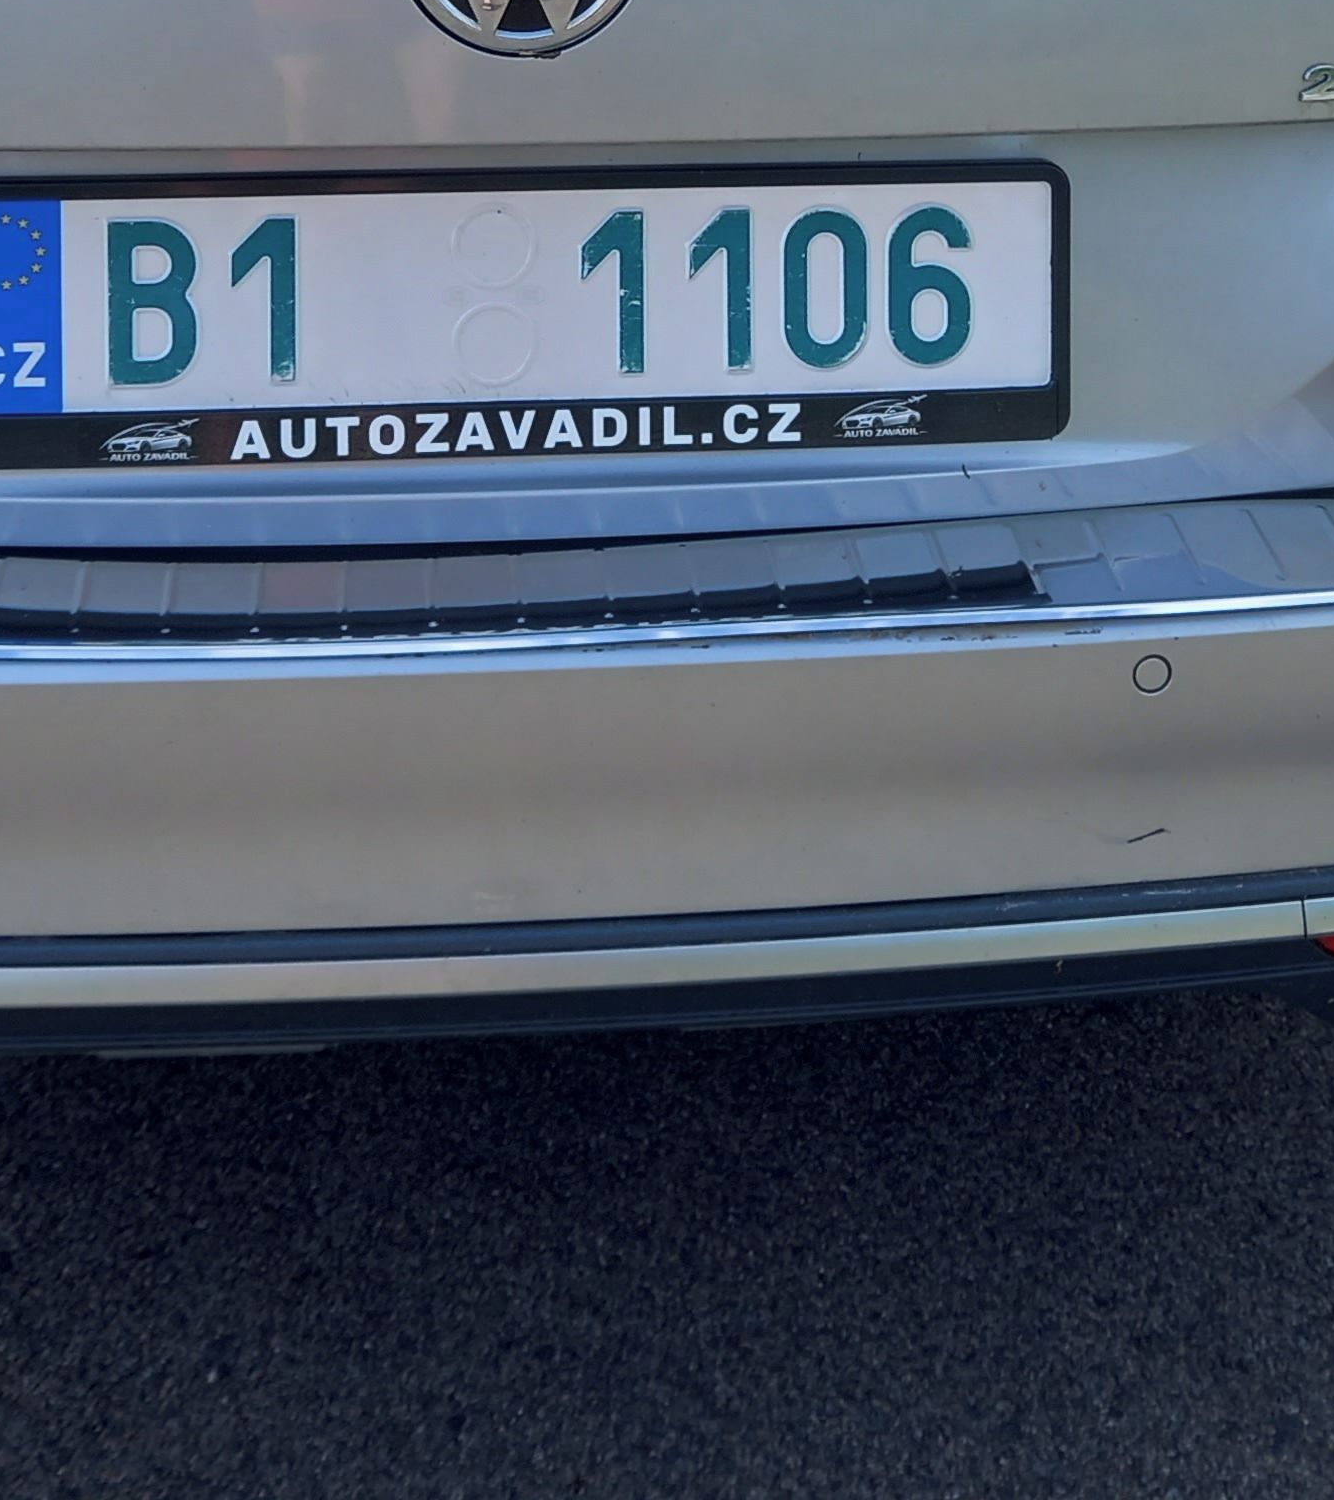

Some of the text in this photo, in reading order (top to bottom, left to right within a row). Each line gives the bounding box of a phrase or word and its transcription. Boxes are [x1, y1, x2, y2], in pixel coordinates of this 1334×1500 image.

[105, 202, 973, 388] B1 1106
[229, 402, 803, 461] AUTOZAVADIL.CZ
[843, 427, 920, 438] AUTO ZAVADIL
[109, 452, 190, 462] AUTO ZAVADIL
